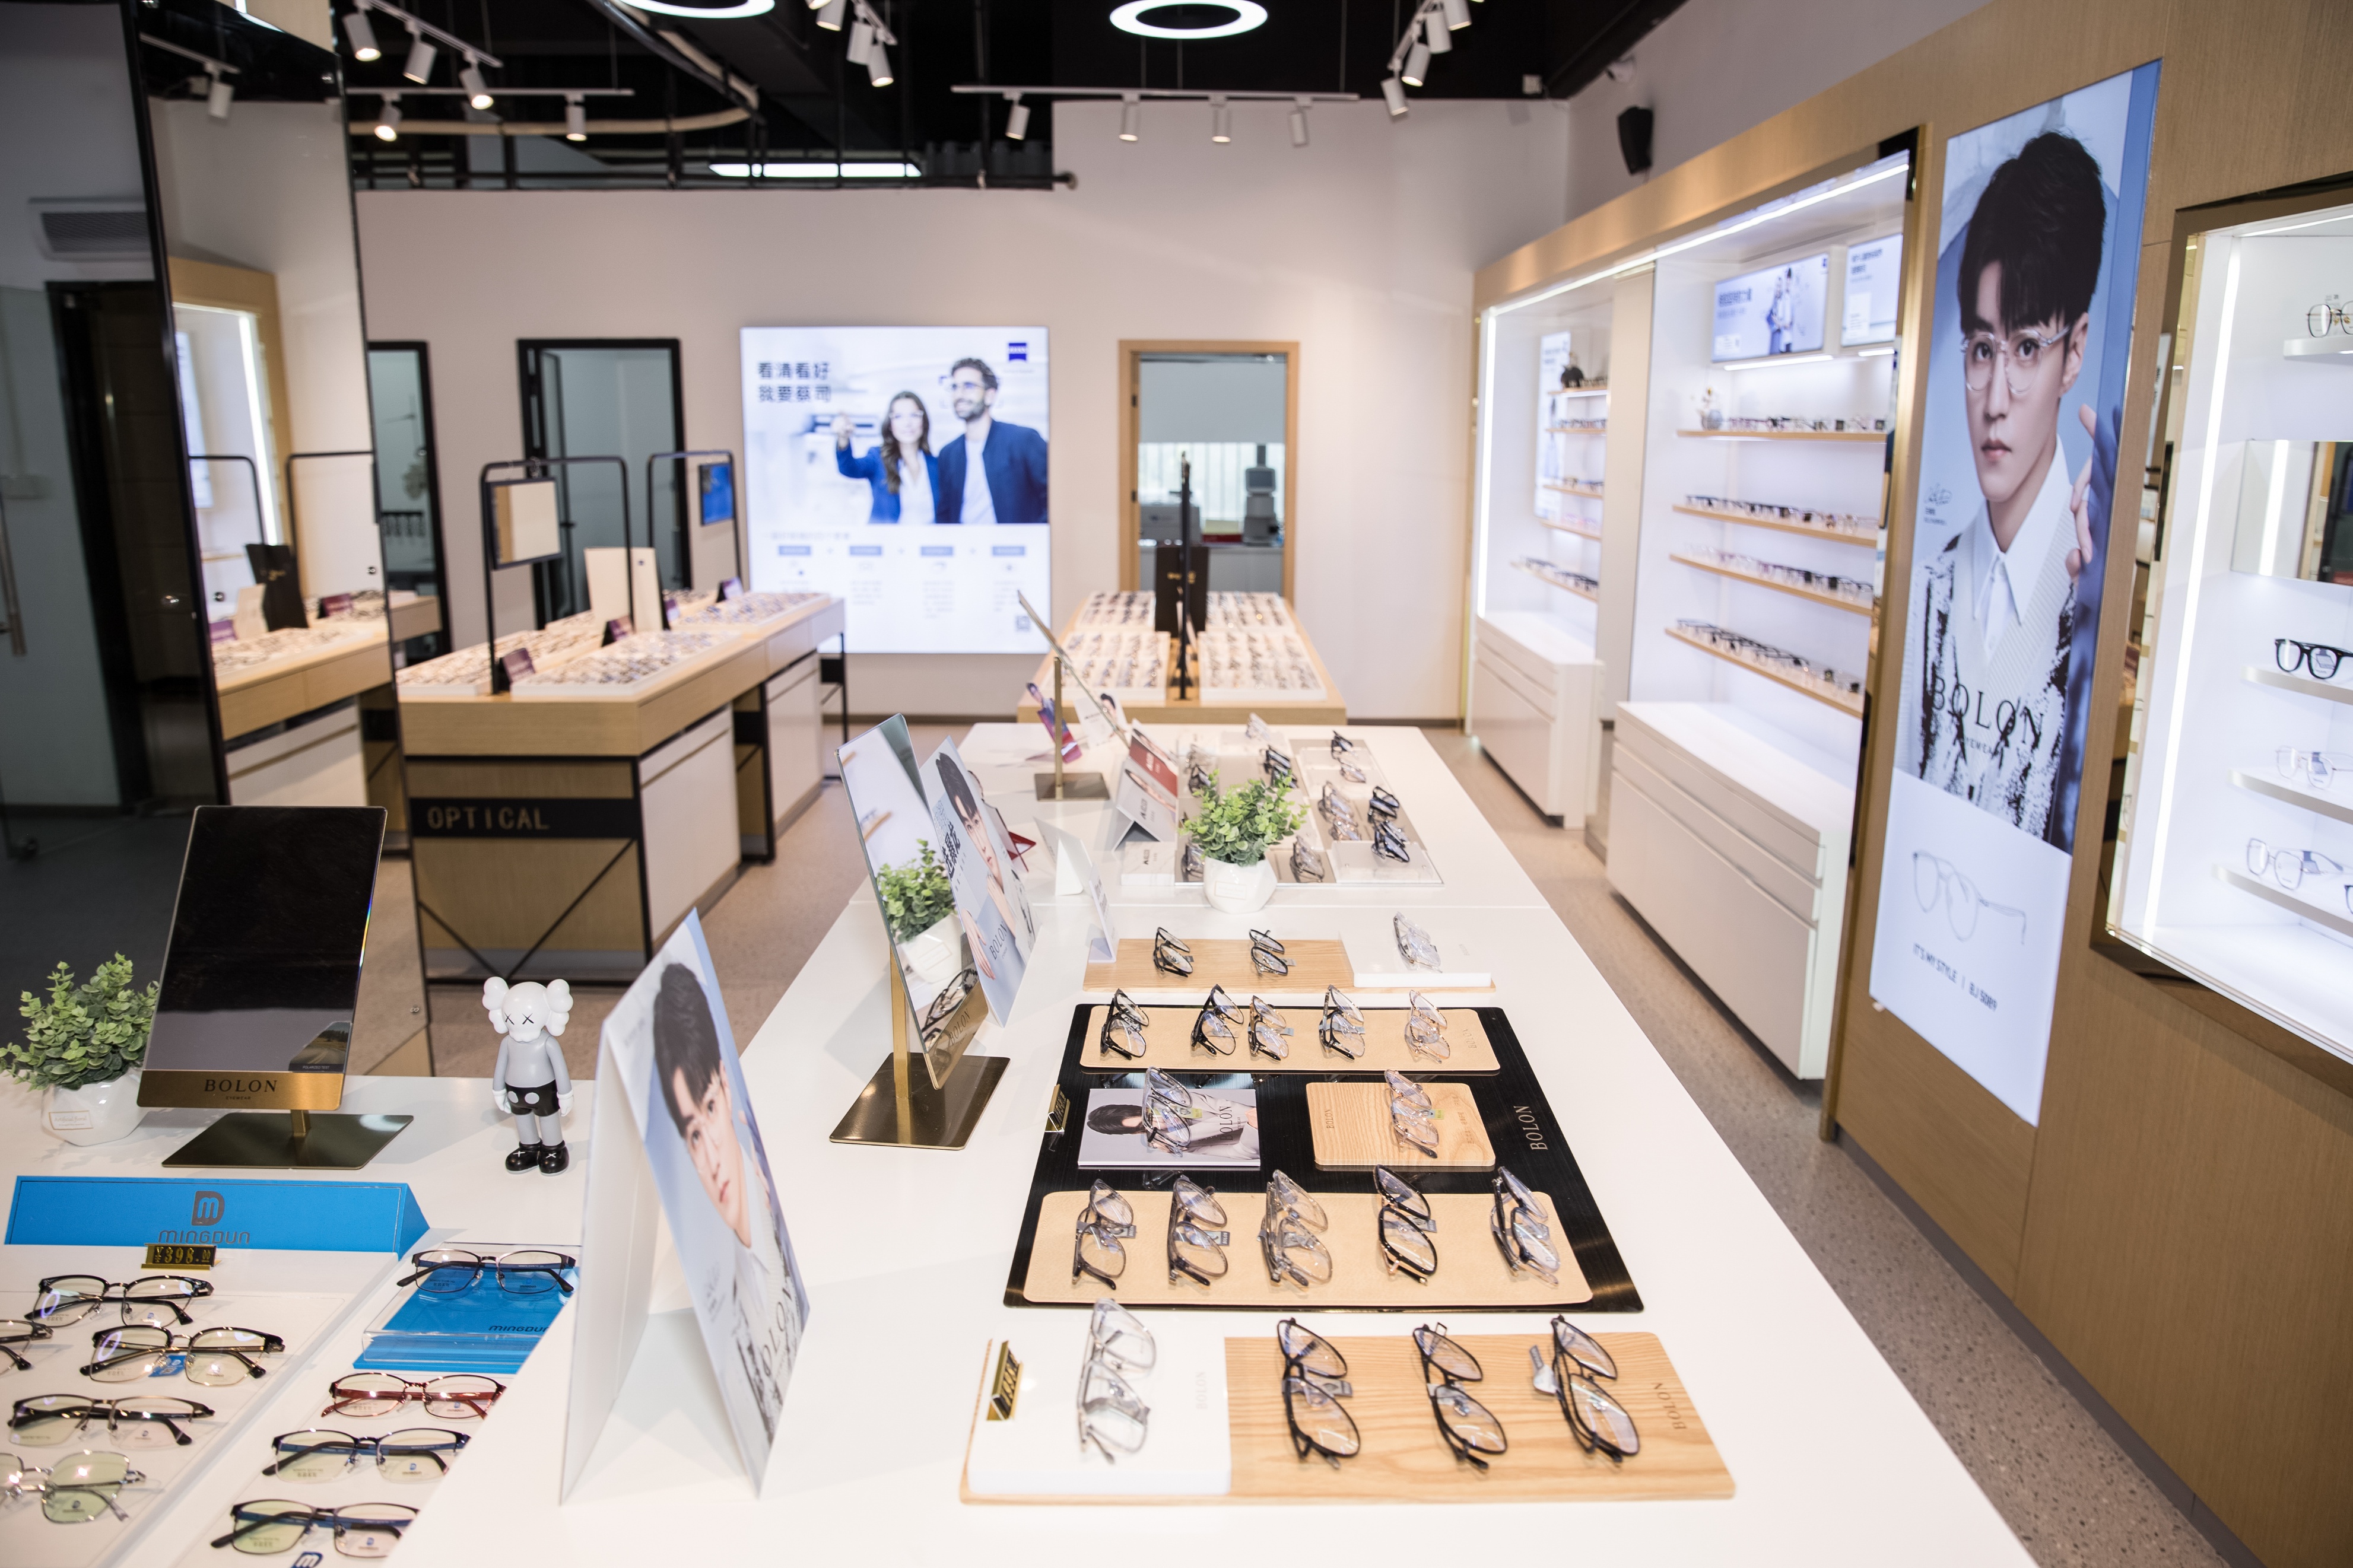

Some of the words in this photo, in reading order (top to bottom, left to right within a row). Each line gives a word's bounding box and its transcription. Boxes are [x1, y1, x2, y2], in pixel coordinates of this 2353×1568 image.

[758, 362, 829, 378] 看清看好
[1933, 676, 2044, 750] BOLON
[427, 806, 550, 830] OPTICAL
[989, 921, 1008, 960] BOLON
[949, 1008, 971, 1047] BOLON
[204, 1079, 278, 1092] BOLON
[1220, 1106, 1233, 1141] BOLON
[1325, 1109, 1335, 1129] BOLON
[1513, 1105, 1548, 1150] BOLON
[1195, 1371, 1207, 1410] BOLON
[1652, 1382, 1687, 1430] BOLON
